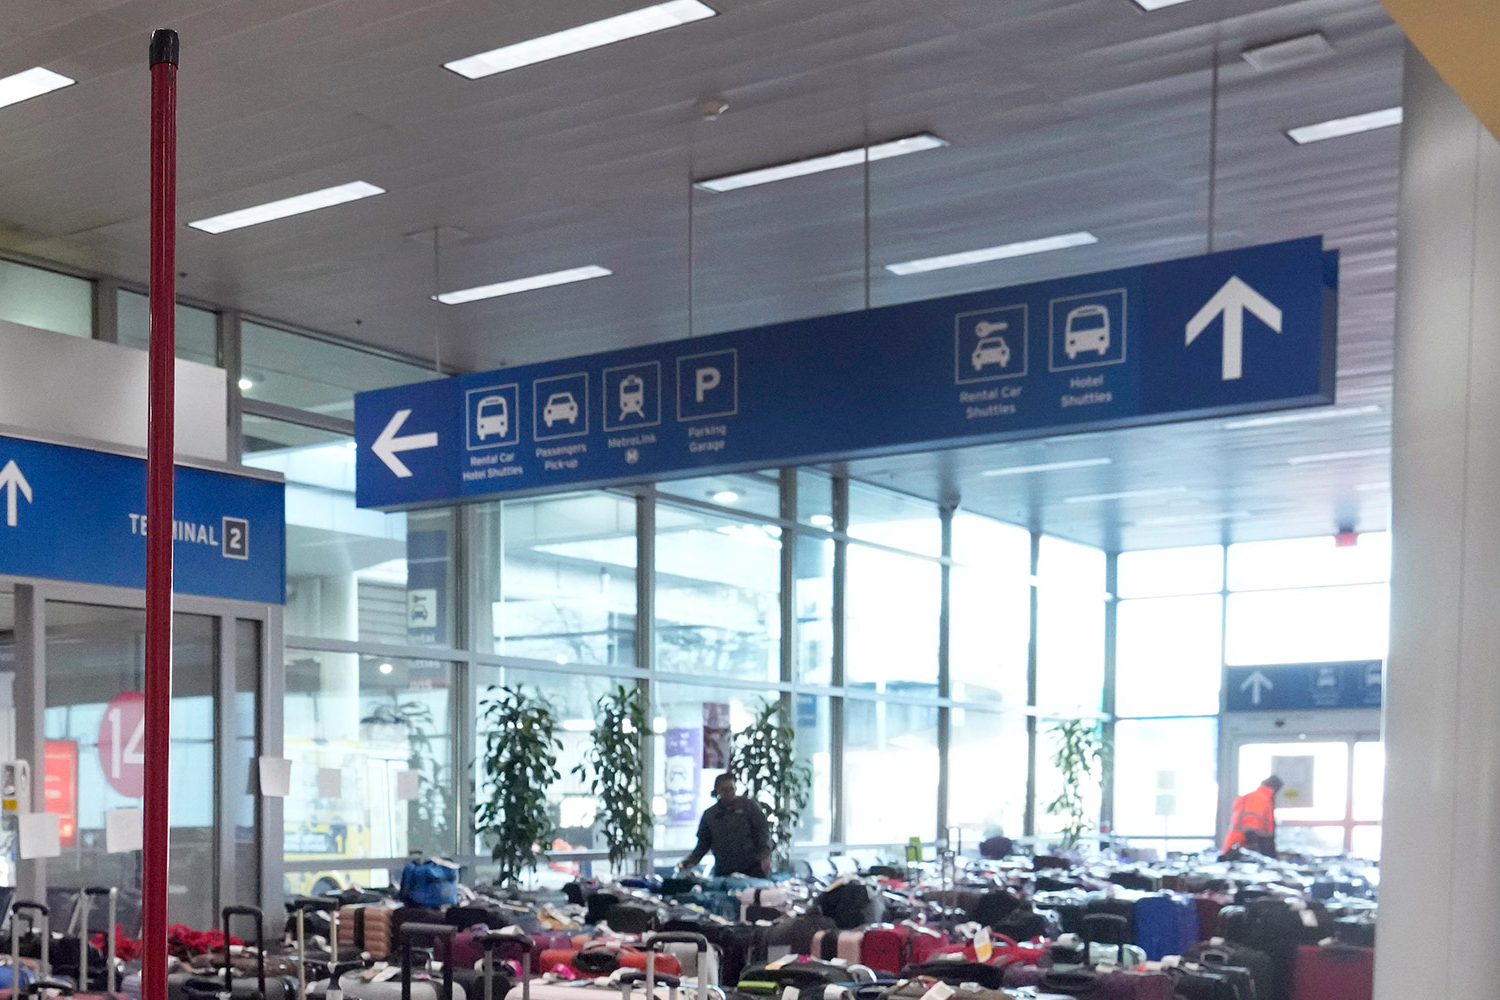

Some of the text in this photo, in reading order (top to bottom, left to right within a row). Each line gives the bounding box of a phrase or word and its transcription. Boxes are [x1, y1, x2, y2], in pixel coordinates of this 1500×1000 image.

[695, 366, 721, 402] P
[1069, 374, 1104, 389] Hotel
[959, 385, 1023, 402] Rental Car
[1061, 390, 1113, 408] Shuttles
[965, 403, 1017, 419] Shuttles
[687, 424, 727, 438] Parking
[607, 432, 657, 449] MetroLink
[689, 439, 726, 453] Garage
[469, 452, 515, 467] Rental Car
[462, 466, 524, 481] Hotel Shuttles
[128, 513, 241, 550] TEINAL 2
